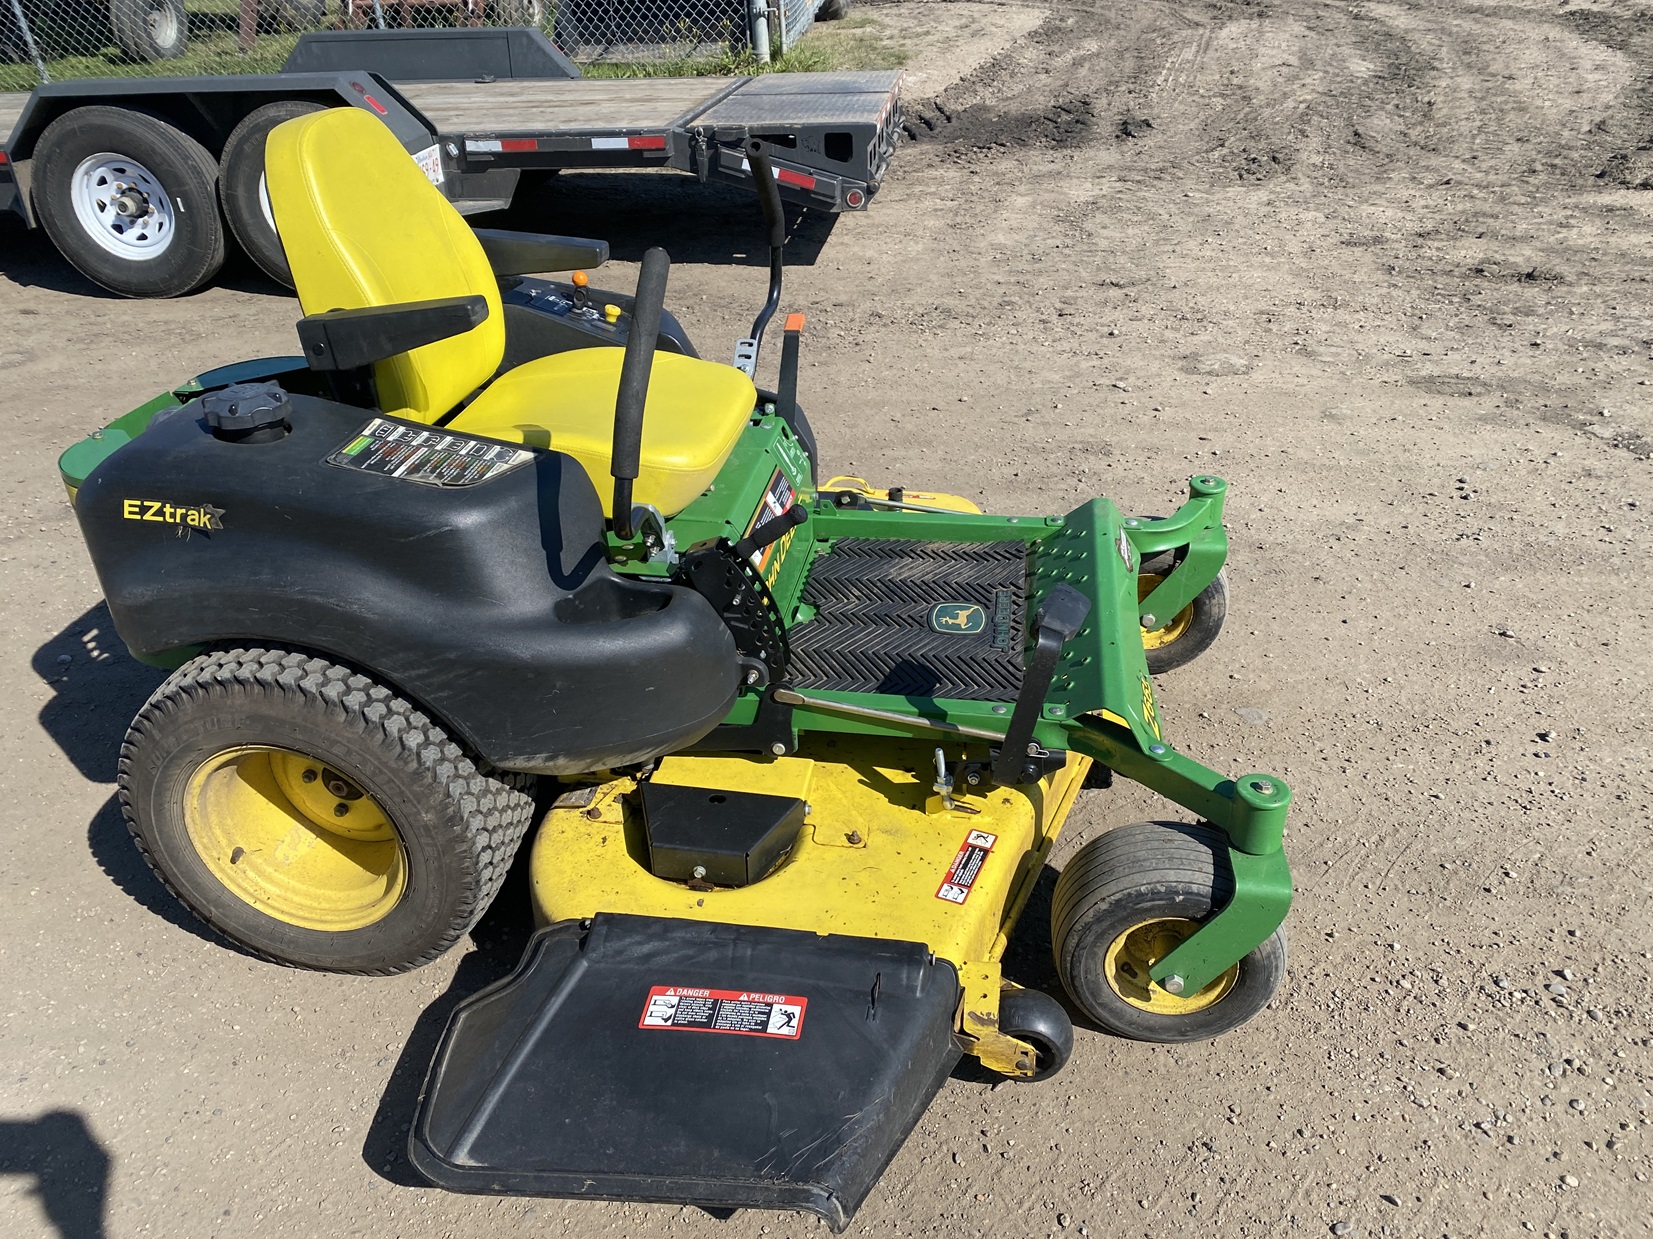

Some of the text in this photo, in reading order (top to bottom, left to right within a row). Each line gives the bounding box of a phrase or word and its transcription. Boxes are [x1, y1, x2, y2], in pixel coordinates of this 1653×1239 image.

[123, 499, 212, 530] EZtrak
[991, 590, 1011, 653] JOHN DEERE
[952, 850, 965, 871] DANGER
[676, 988, 710, 997] DANGER
[749, 993, 785, 1004] PELIGRO
